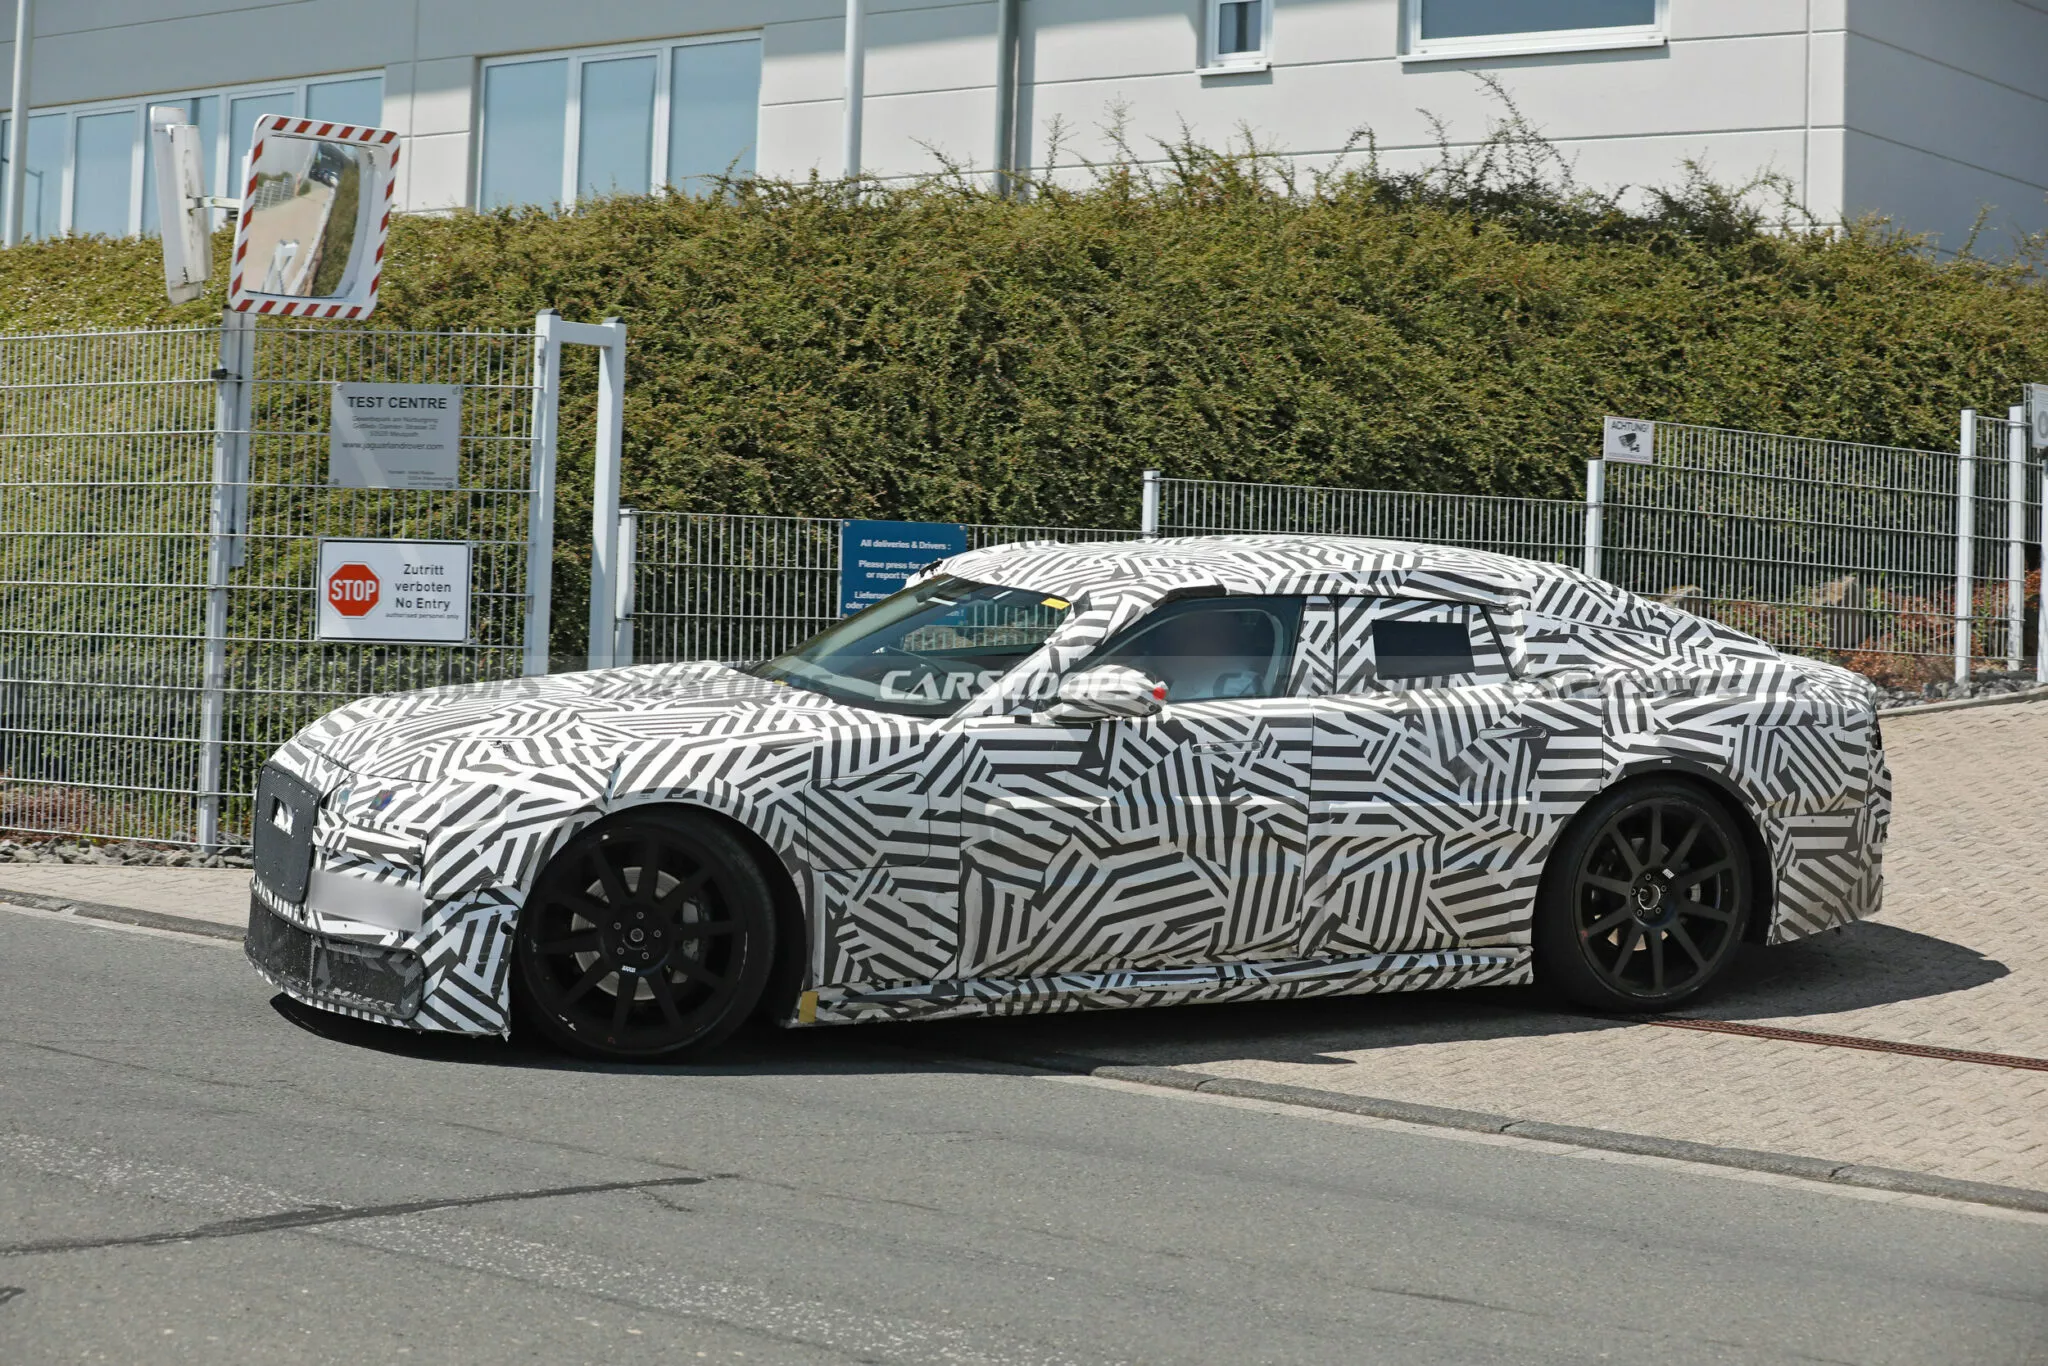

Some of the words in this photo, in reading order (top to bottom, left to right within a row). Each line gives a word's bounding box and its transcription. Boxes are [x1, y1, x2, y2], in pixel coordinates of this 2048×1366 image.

[348, 396, 384, 408] TEST
[388, 397, 448, 409] CENTRE
[860, 539, 872, 547] All
[873, 540, 910, 549] deliveries
[919, 542, 946, 550] Drivers
[403, 564, 444, 575] Zutritt
[858, 560, 884, 568] Please
[886, 562, 907, 570] press
[909, 561, 919, 569] for
[876, 572, 900, 580] report
[331, 579, 376, 602] STOP
[395, 581, 451, 592] verboten
[396, 597, 412, 608] No
[416, 597, 450, 611] Entry
